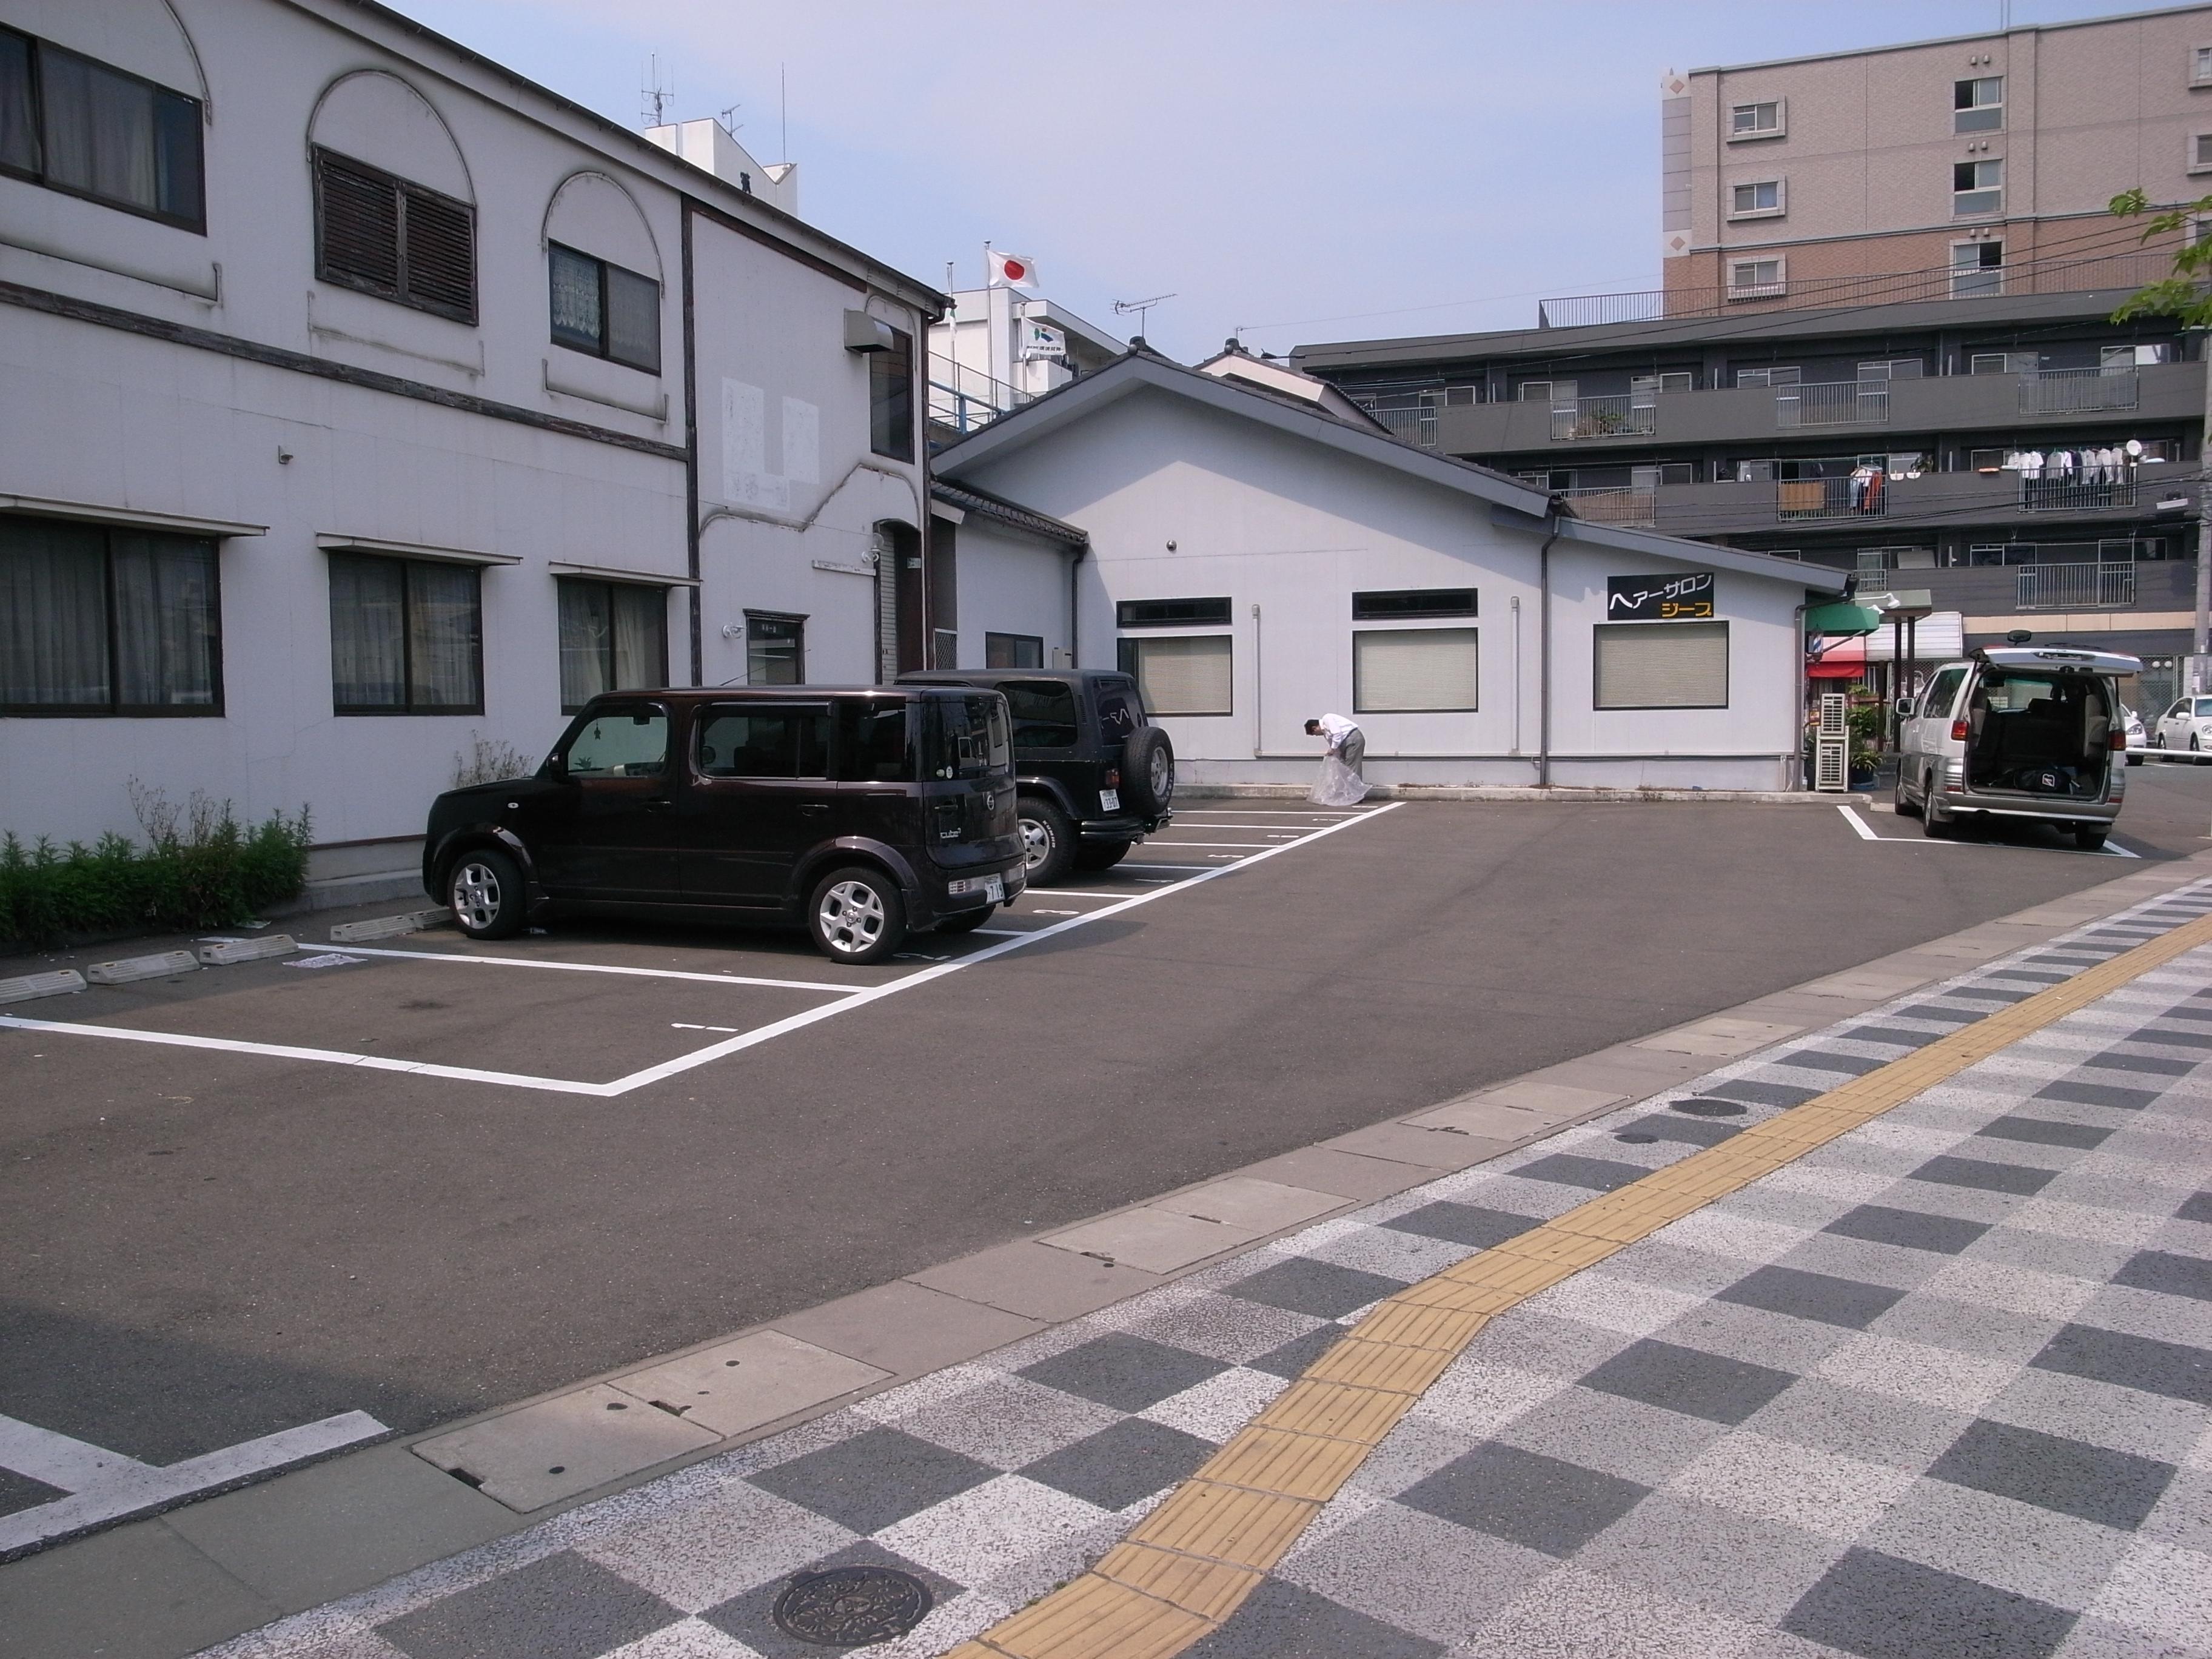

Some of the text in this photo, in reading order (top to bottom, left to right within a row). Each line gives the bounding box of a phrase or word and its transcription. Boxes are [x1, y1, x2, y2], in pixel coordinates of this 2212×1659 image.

[1609, 574, 1712, 611] ヘアーサロン
[1661, 602, 1712, 618] ジープ
[1042, 820, 1056, 848] KUMHO
